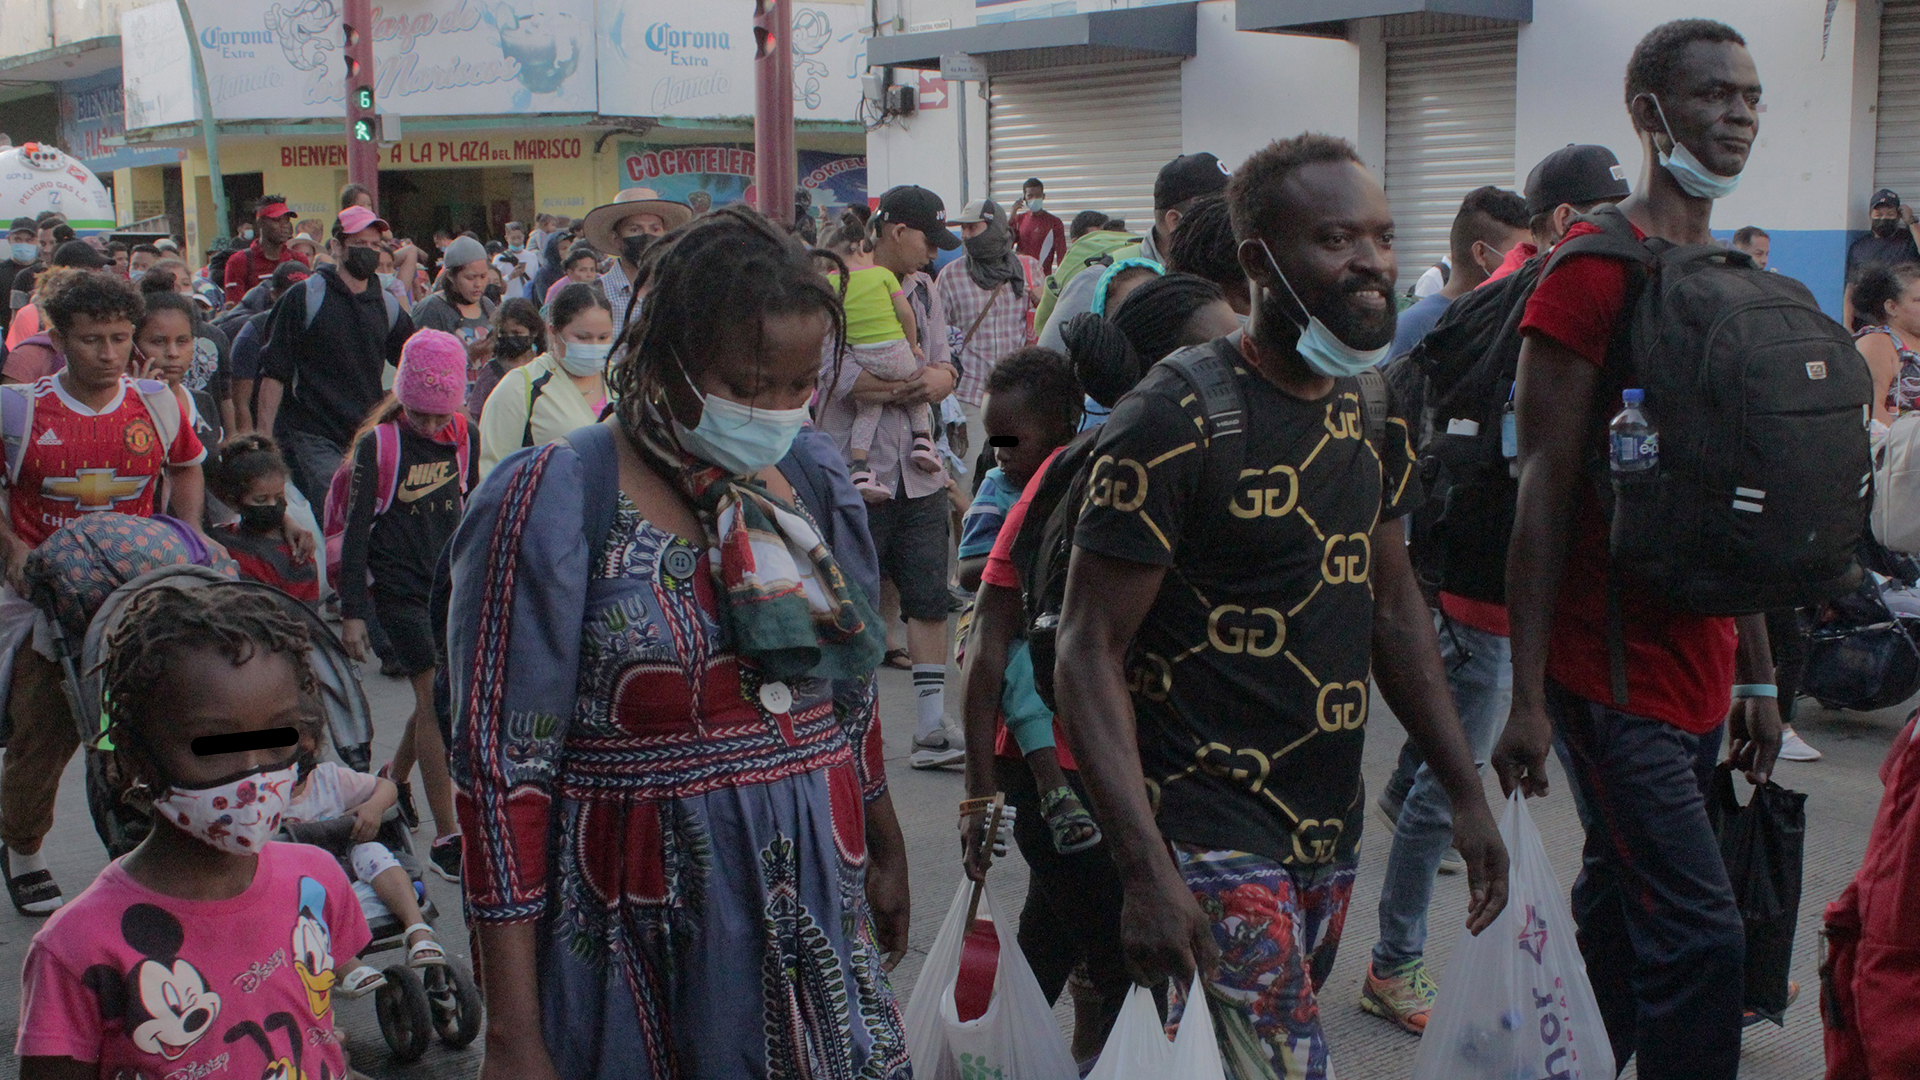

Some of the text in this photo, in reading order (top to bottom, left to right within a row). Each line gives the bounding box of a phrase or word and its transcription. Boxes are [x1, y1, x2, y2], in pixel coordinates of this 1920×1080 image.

[200, 26, 273, 51] Corona
[645, 22, 730, 55] Corona
[222, 47, 255, 58] Extra
[671, 50, 708, 66] Extra
[360, 91, 370, 108] 6
[281, 138, 581, 167] BIENVEN A LA PLAZA DEL MARISCO
[626, 147, 756, 182] COCKTELER
[802, 157, 868, 189] COKTEL
[19, 180, 54, 205] PELIGRO
[55, 181, 75, 193] GAS
[406, 460, 451, 487] NIKE
[410, 499, 454, 515] AIR
[232, 947, 288, 993] Disney
